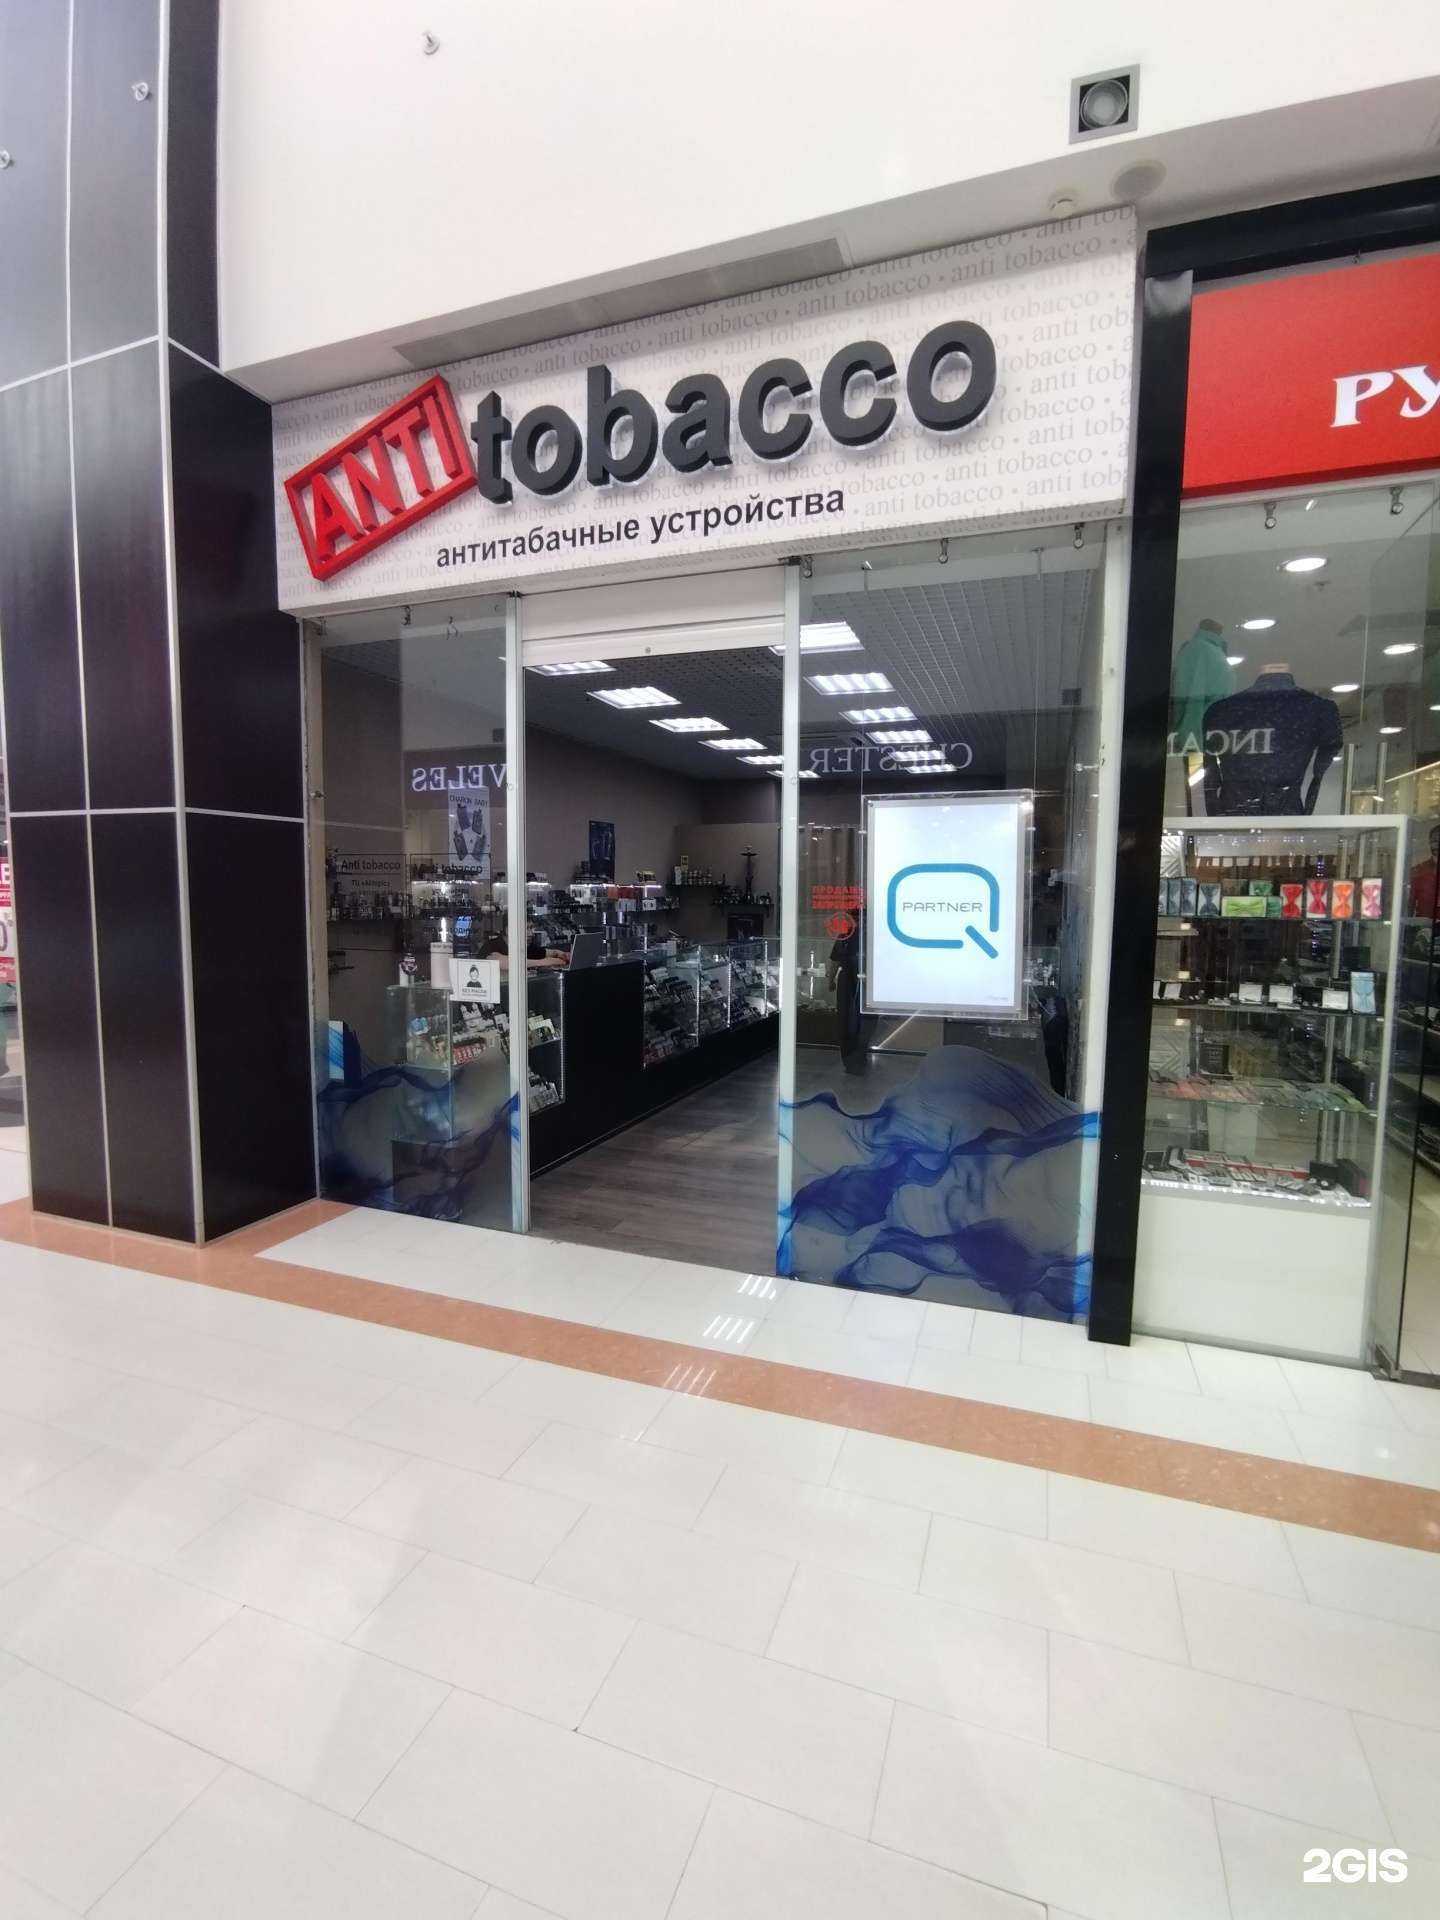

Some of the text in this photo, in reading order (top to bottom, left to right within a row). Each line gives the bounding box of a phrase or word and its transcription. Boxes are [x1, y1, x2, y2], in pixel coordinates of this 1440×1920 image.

[571, 339, 639, 365] tobacco
[699, 309, 775, 337] tobacco
[796, 290, 834, 316] anti
[842, 275, 927, 306] tobacco
[951, 255, 994, 283] anti
[1002, 237, 1098, 272] tobacco
[1034, 314, 1079, 342] anti
[999, 343, 1095, 374] tobacco
[1032, 357, 1125, 393] anti tob
[1000, 395, 1093, 424] tobacco
[311, 320, 997, 561] ANTI tobacco
[871, 445, 909, 468] anti
[919, 435, 1006, 461] tobacco
[1033, 418, 1076, 444] anti
[1087, 409, 1123, 435] tob
[948, 457, 988, 481] anti
[999, 447, 1091, 474] tobacco
[870, 493, 908, 516] anti
[918, 485, 1005, 509] tobacco
[1031, 469, 1074, 494] anti
[1085, 462, 1121, 487] tob
[437, 516, 640, 567] антитабачные
[650, 489, 845, 545] устройства
[902, 902, 983, 913] PARTNER
